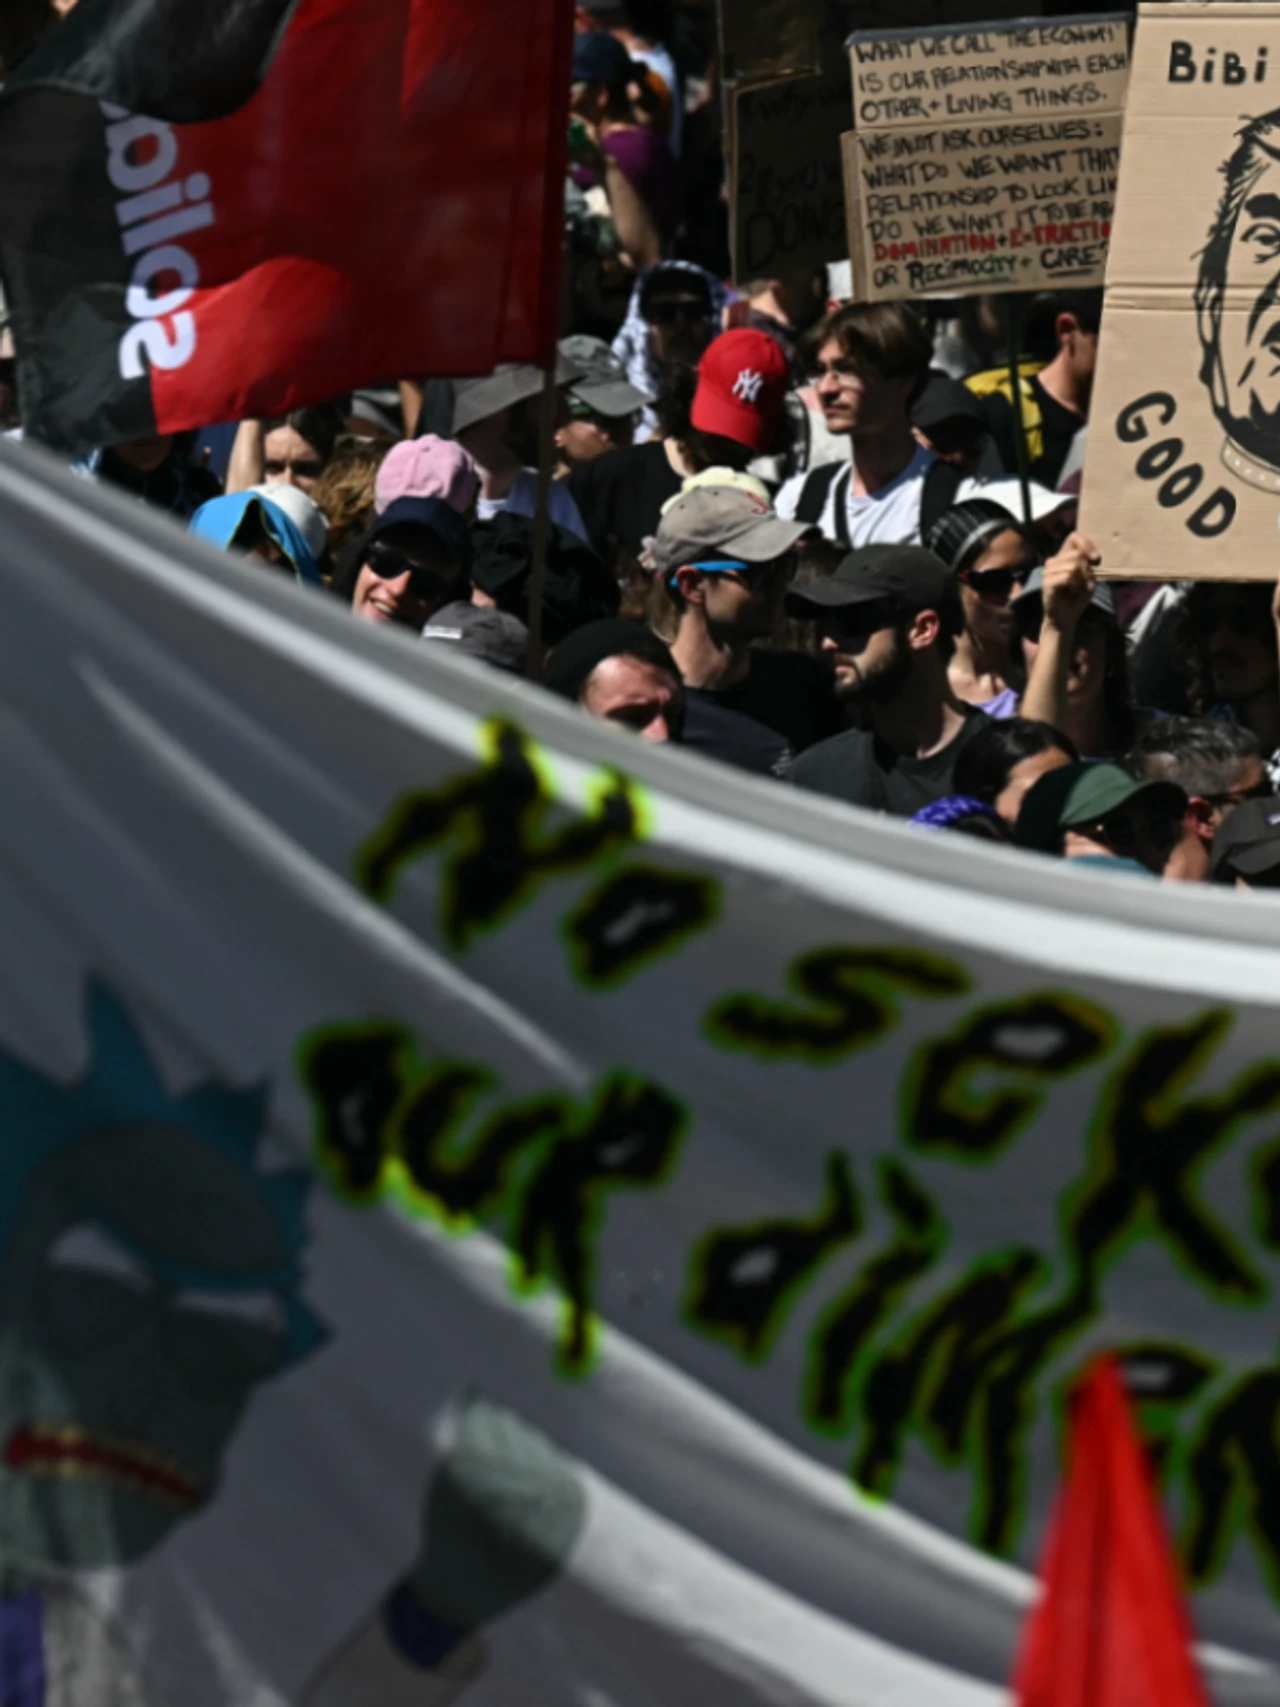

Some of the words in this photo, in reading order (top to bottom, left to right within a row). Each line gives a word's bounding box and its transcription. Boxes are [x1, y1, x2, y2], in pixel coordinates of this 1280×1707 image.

[919, 36, 949, 58] WE
[858, 72, 884, 94] IS
[888, 69, 929, 92] OUR
[1086, 52, 1126, 75] EACH
[859, 132, 892, 162] WE
[956, 154, 996, 181] WE
[995, 149, 1066, 176] WANT
[1085, 176, 1117, 197] LIK
[867, 219, 902, 243] DO
[912, 214, 944, 238] WE
[731, 367, 764, 403] NY
[1114, 390, 1237, 538] GOOD
